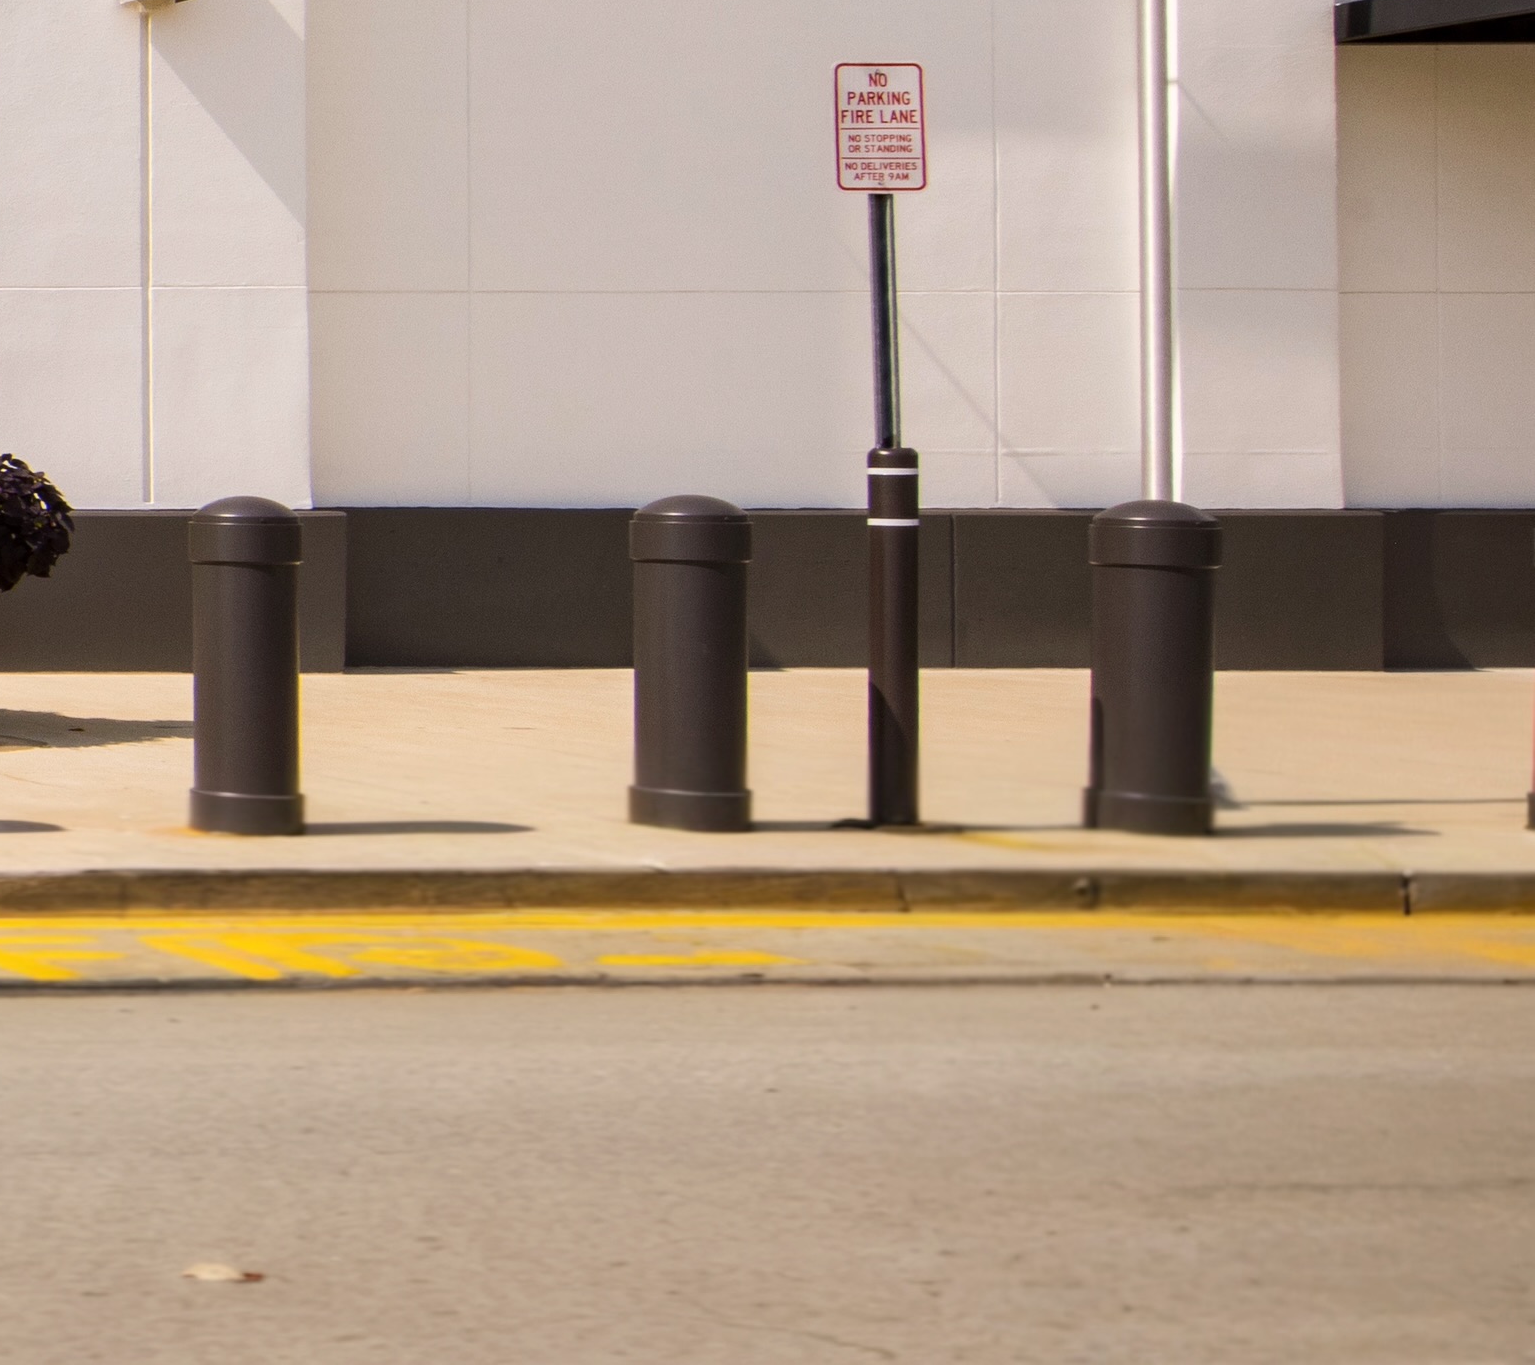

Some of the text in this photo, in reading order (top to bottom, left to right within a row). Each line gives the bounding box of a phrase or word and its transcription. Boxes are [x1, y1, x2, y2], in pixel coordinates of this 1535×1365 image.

[868, 72, 888, 87] NO
[847, 91, 911, 106] PARKING
[840, 109, 919, 124] FIRE LANE
[848, 134, 913, 143] NO STOPPING
[848, 144, 913, 153] OR STANDING
[844, 162, 918, 171] NO DELIVERIES
[853, 172, 885, 181] AFTER
